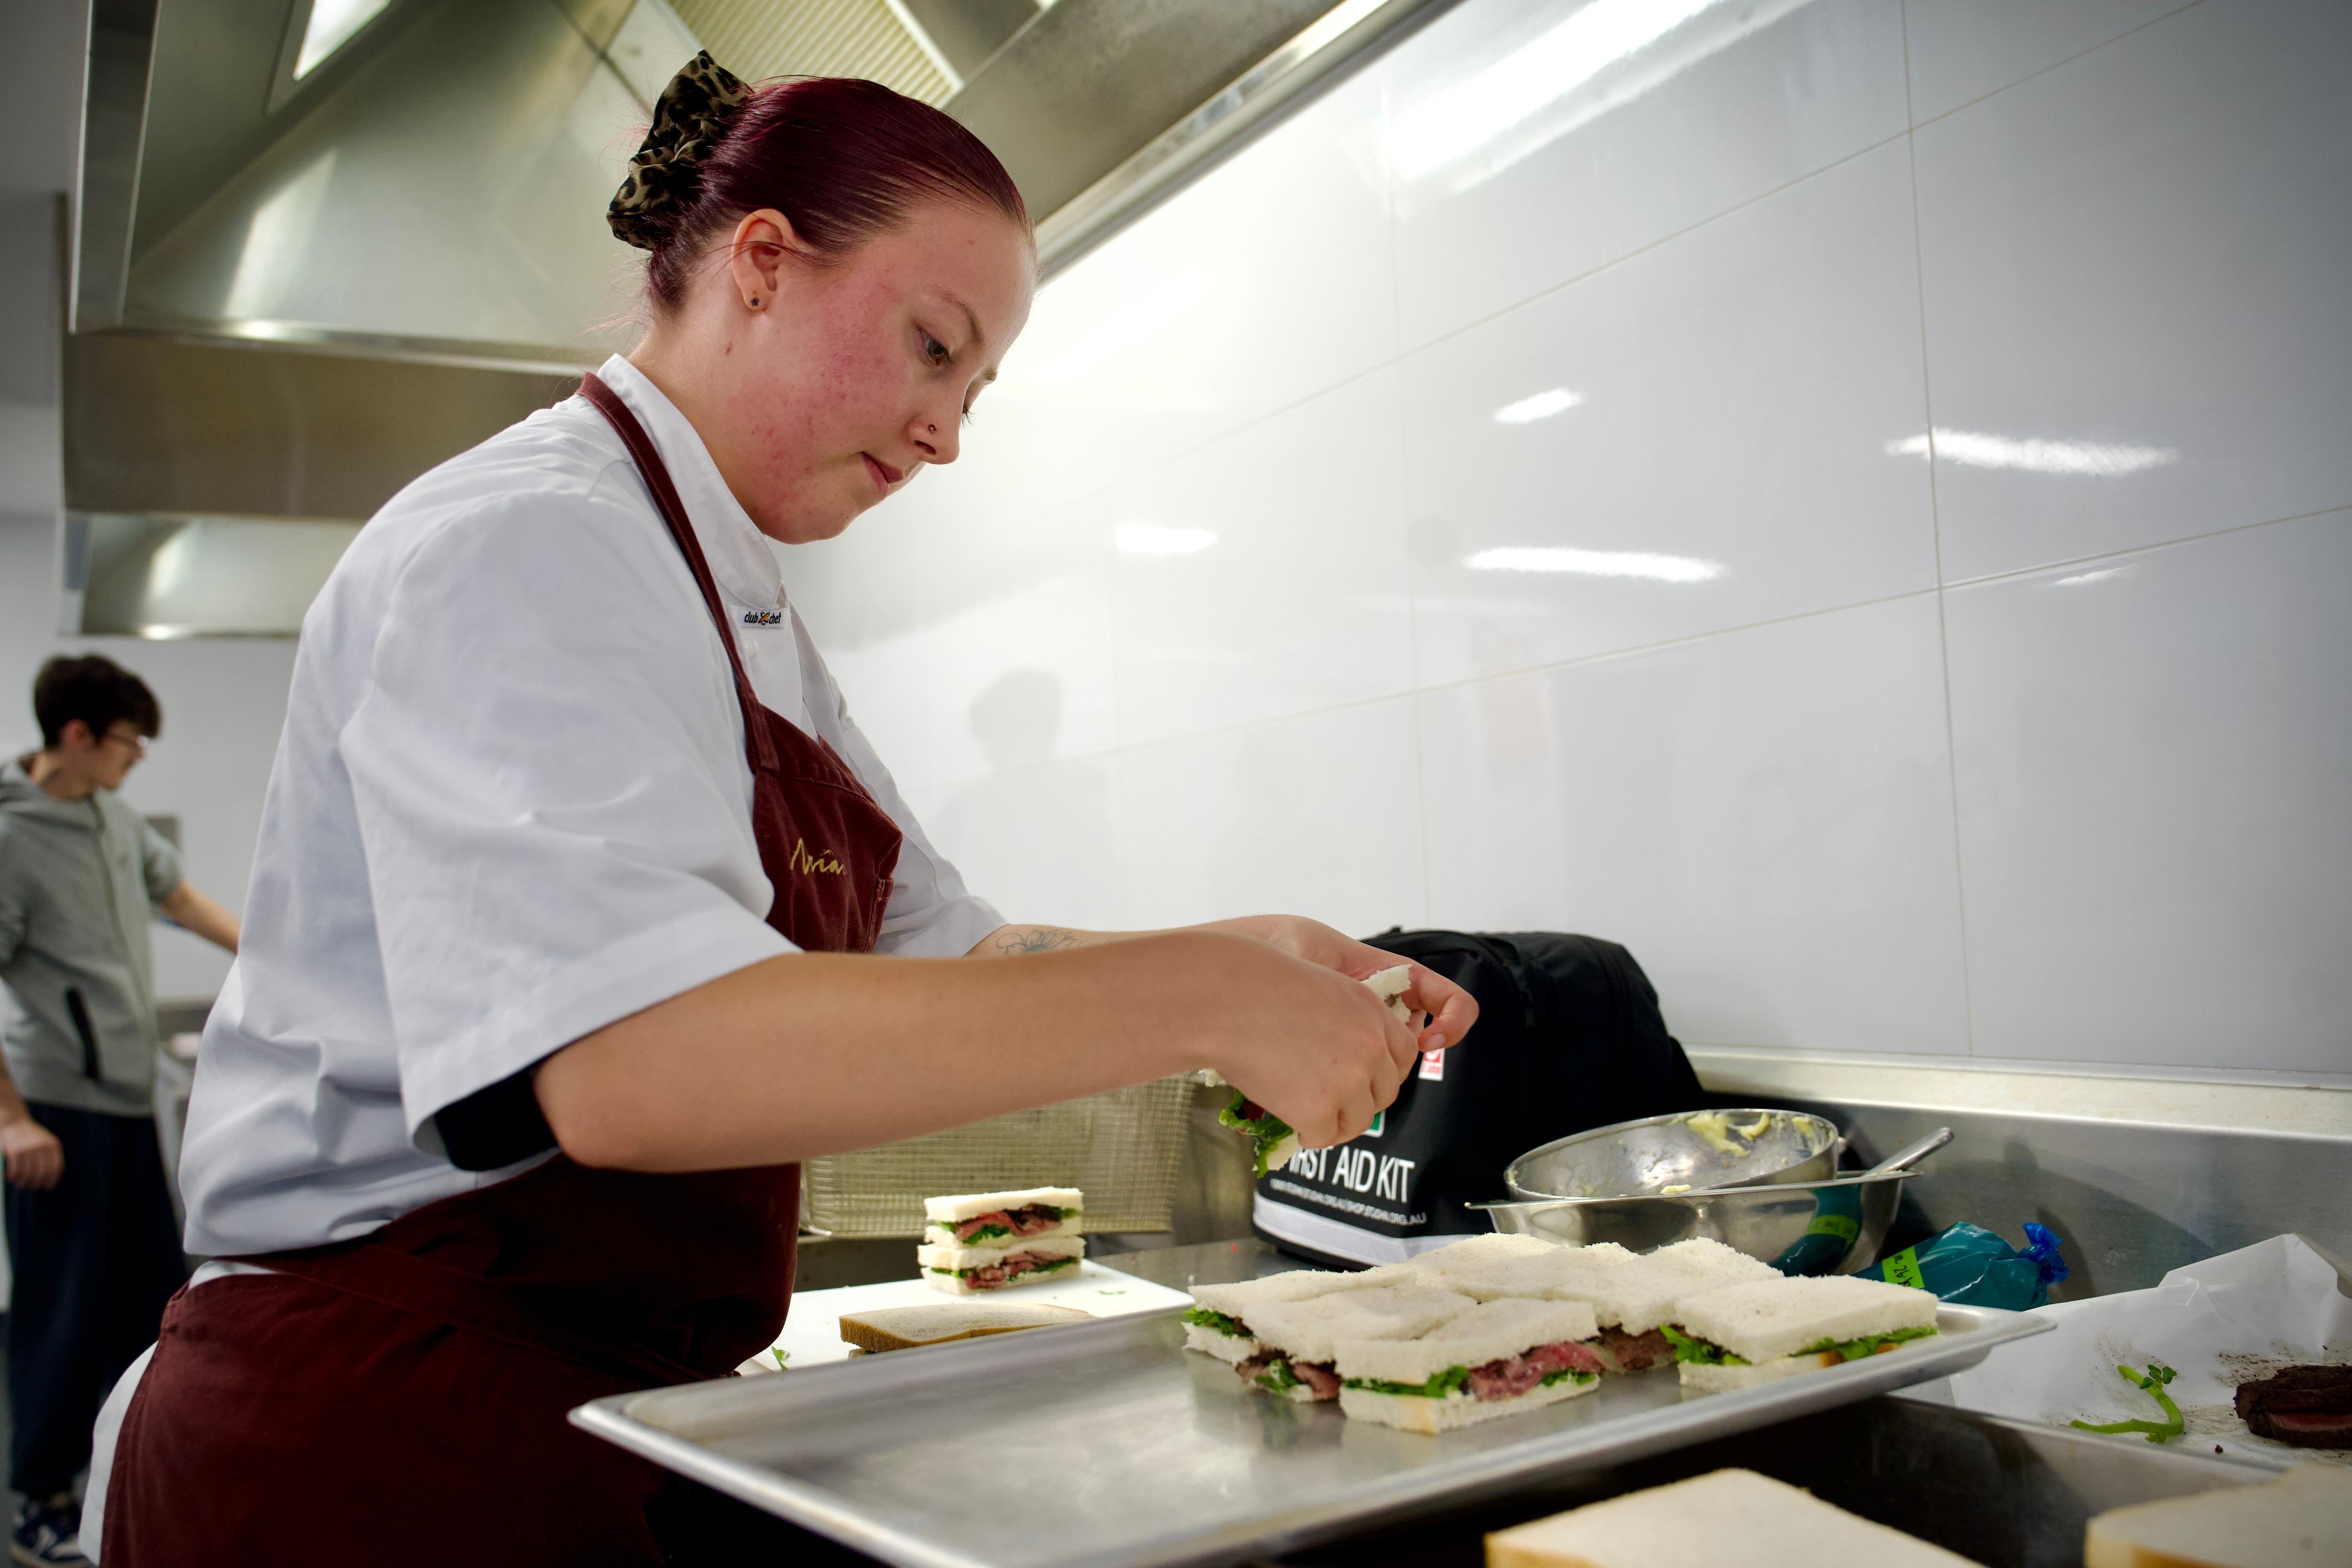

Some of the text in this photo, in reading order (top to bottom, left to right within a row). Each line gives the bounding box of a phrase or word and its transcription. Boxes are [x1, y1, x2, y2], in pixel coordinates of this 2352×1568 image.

[744, 612, 781, 624] club chef
[1289, 1146, 1334, 1182] IRST
[1331, 1145, 1376, 1194] AID
[1375, 1154, 1415, 1204] KIT
